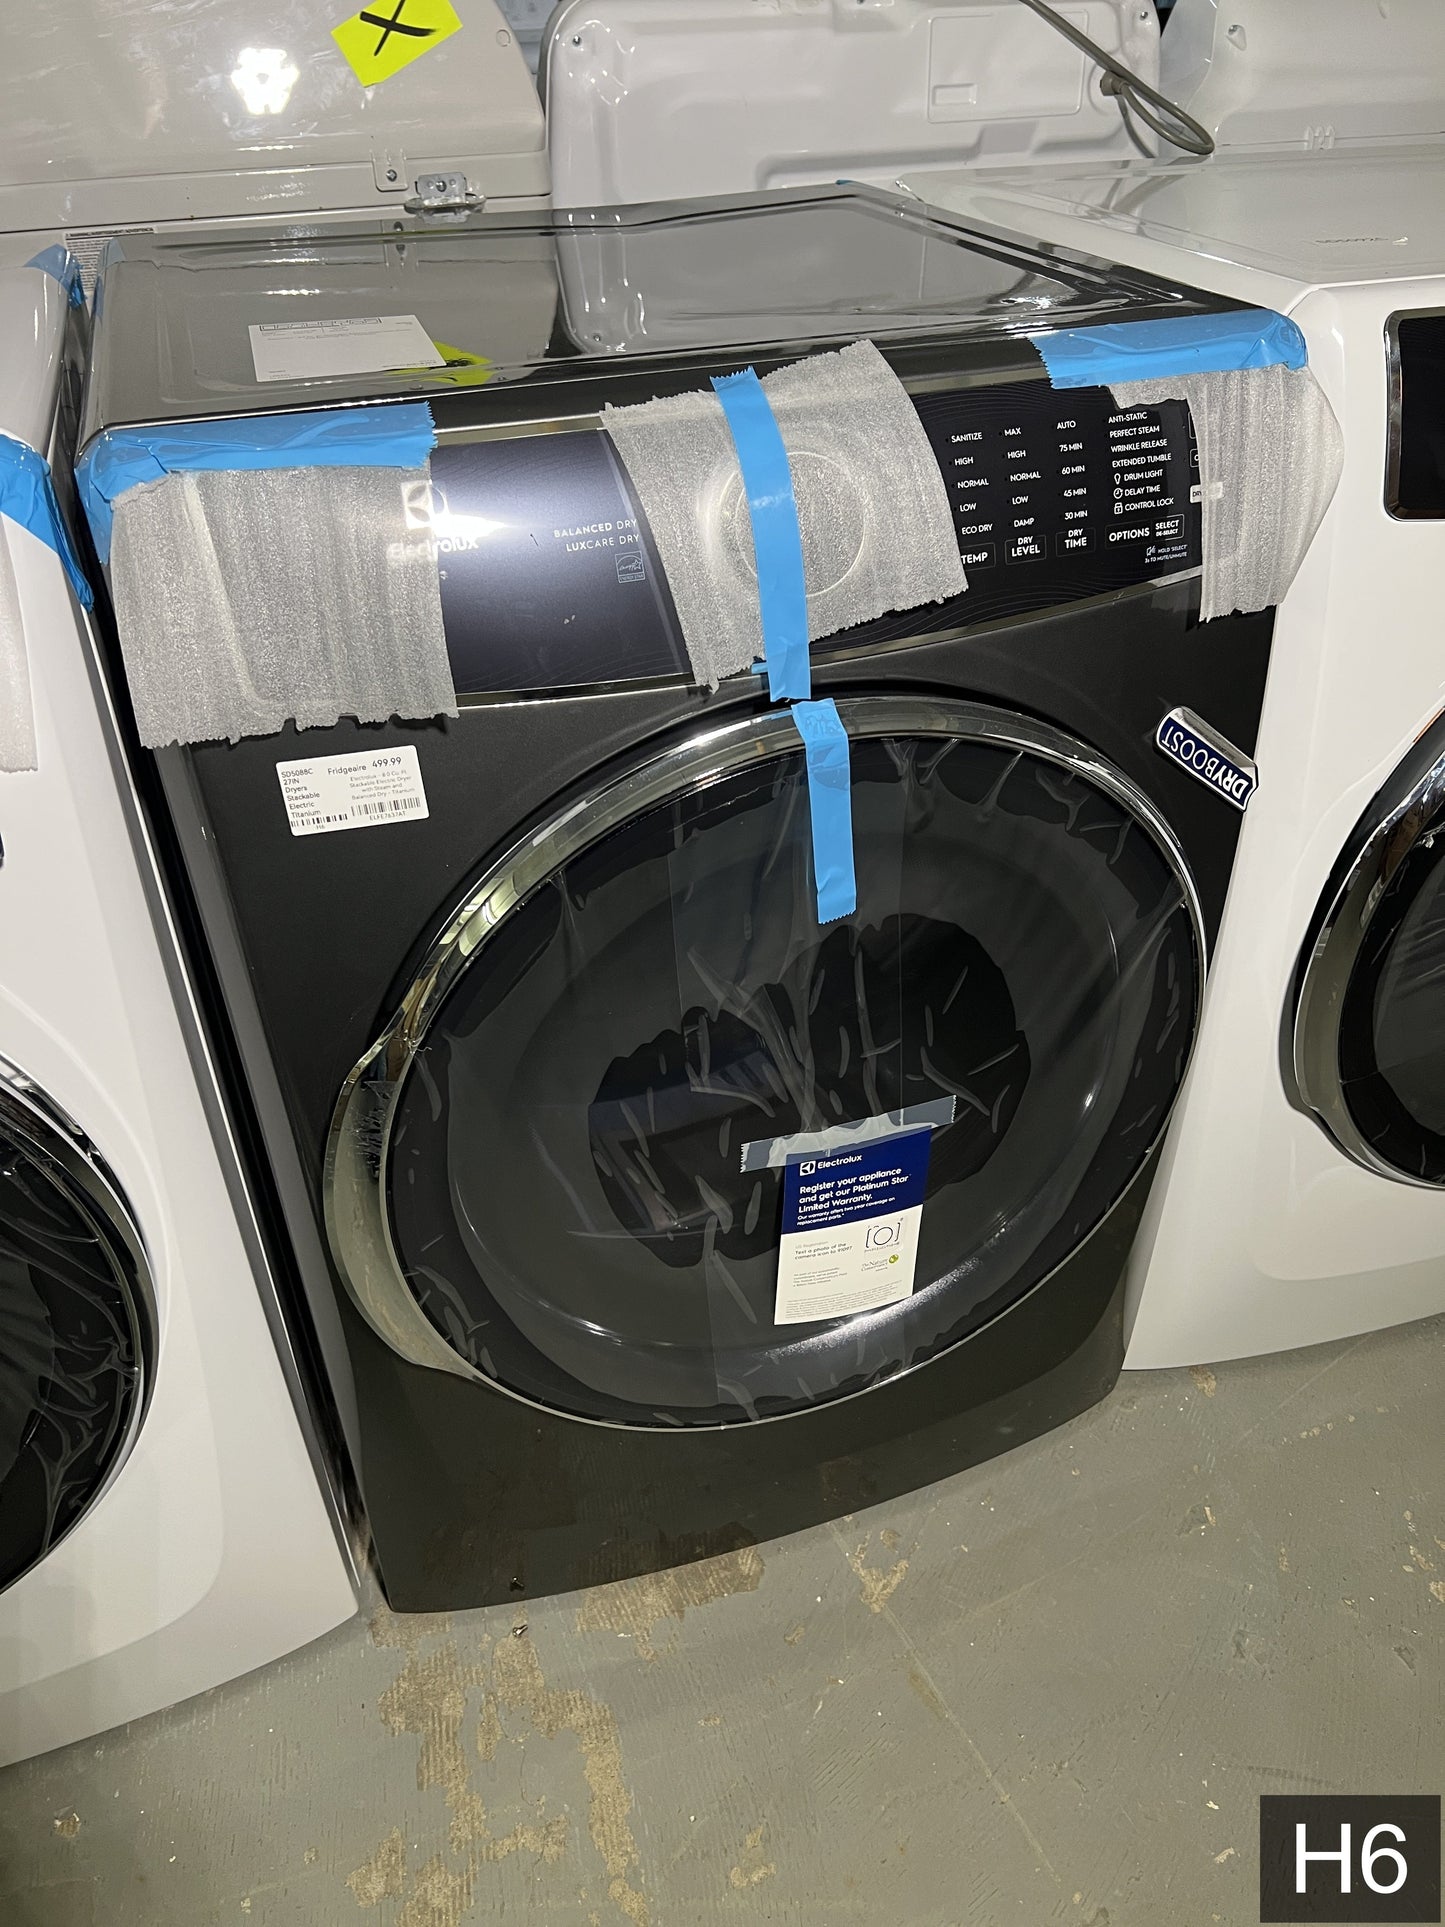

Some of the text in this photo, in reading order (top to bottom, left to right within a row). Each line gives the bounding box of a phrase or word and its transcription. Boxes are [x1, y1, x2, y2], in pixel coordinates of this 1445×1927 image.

[1108, 411, 1148, 424] ANTI-STATIC
[1057, 420, 1076, 429] AUTO
[1005, 427, 1021, 436] MAX
[1109, 425, 1160, 438] PERFECT STEAM
[951, 432, 983, 443] SANITIZE
[1059, 442, 1082, 452] 75 MIN
[1111, 439, 1168, 452] WRINKLE RELEASE
[1008, 450, 1026, 459] HIGH
[954, 457, 974, 466] HIGH
[1112, 453, 1171, 468] EXTENDED TUMBLE
[1061, 465, 1085, 475] 60 MIN
[1124, 469, 1163, 482] DRUM LIGHT
[1010, 471, 1041, 482] NORMAL
[957, 478, 989, 489] NORMAL
[1063, 488, 1087, 497] 45 MIN
[1124, 485, 1160, 496] DELAY TIME
[1012, 496, 1028, 505] LOW
[1125, 498, 1174, 511] CONTROL LOCK
[960, 503, 976, 512] LOW
[1064, 510, 1087, 520] 30 MIN
[553, 519, 637, 538] BALANCED DRY
[1014, 518, 1035, 528] DAMP
[1155, 520, 1179, 530] SELECT
[962, 524, 993, 535] ECO DRY
[1068, 529, 1083, 538] DRY
[1109, 528, 1150, 542] OPTIONS
[1156, 528, 1178, 537] DE-SELECT
[565, 534, 640, 552] LUXCARE DRY
[1017, 536, 1033, 544] DRY
[1065, 537, 1087, 549] TIME
[1011, 545, 1040, 557] LEVEL
[961, 552, 988, 564] TEMP
[372, 757, 402, 768] 499.99
[1162, 726, 1249, 800] DRYBOOST
[327, 764, 366, 775] Fridgeaire
[286, 785, 307, 794] Dryers
[287, 792, 320, 802] Stackable
[290, 801, 314, 810] Electric
[291, 809, 321, 818] Titanium
[818, 1154, 862, 1169] Electrolux
[800, 1168, 902, 1194] Register your appliance
[799, 1175, 909, 1204] and get our Platinum Star
[798, 1193, 872, 1213] Limited Warranty.
[808, 1210, 829, 1220] warranty
[830, 1207, 844, 1215] offers
[866, 1198, 887, 1207] coverage
[797, 1217, 828, 1226] replacement
